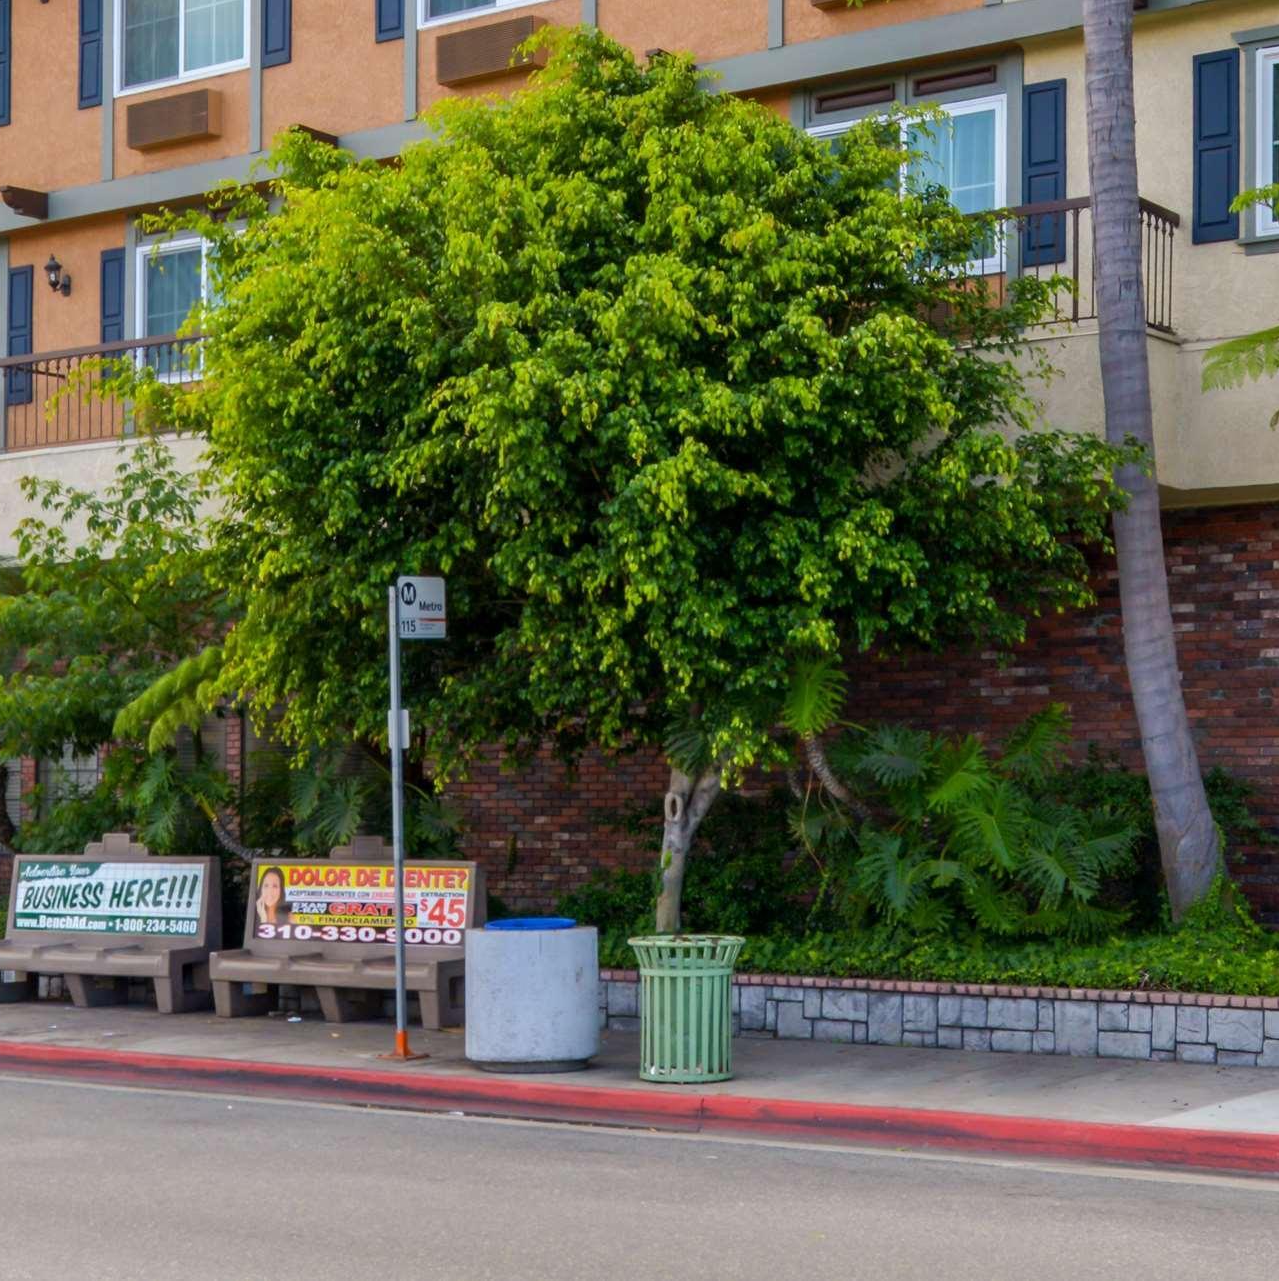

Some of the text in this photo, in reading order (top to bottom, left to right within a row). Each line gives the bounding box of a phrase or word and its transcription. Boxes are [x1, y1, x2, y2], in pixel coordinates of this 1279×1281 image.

[419, 601, 442, 612] Metro
[401, 620, 417, 633] 115
[288, 868, 468, 889] DOLOR DE DENTE?
[22, 874, 199, 910] BUSINESS HERE!!!
[17, 914, 106, 930] www.BenchAd.com
[319, 916, 414, 926] FINANCIAMIENO
[419, 898, 466, 928] $45
[258, 923, 462, 945] 310-330-9000
